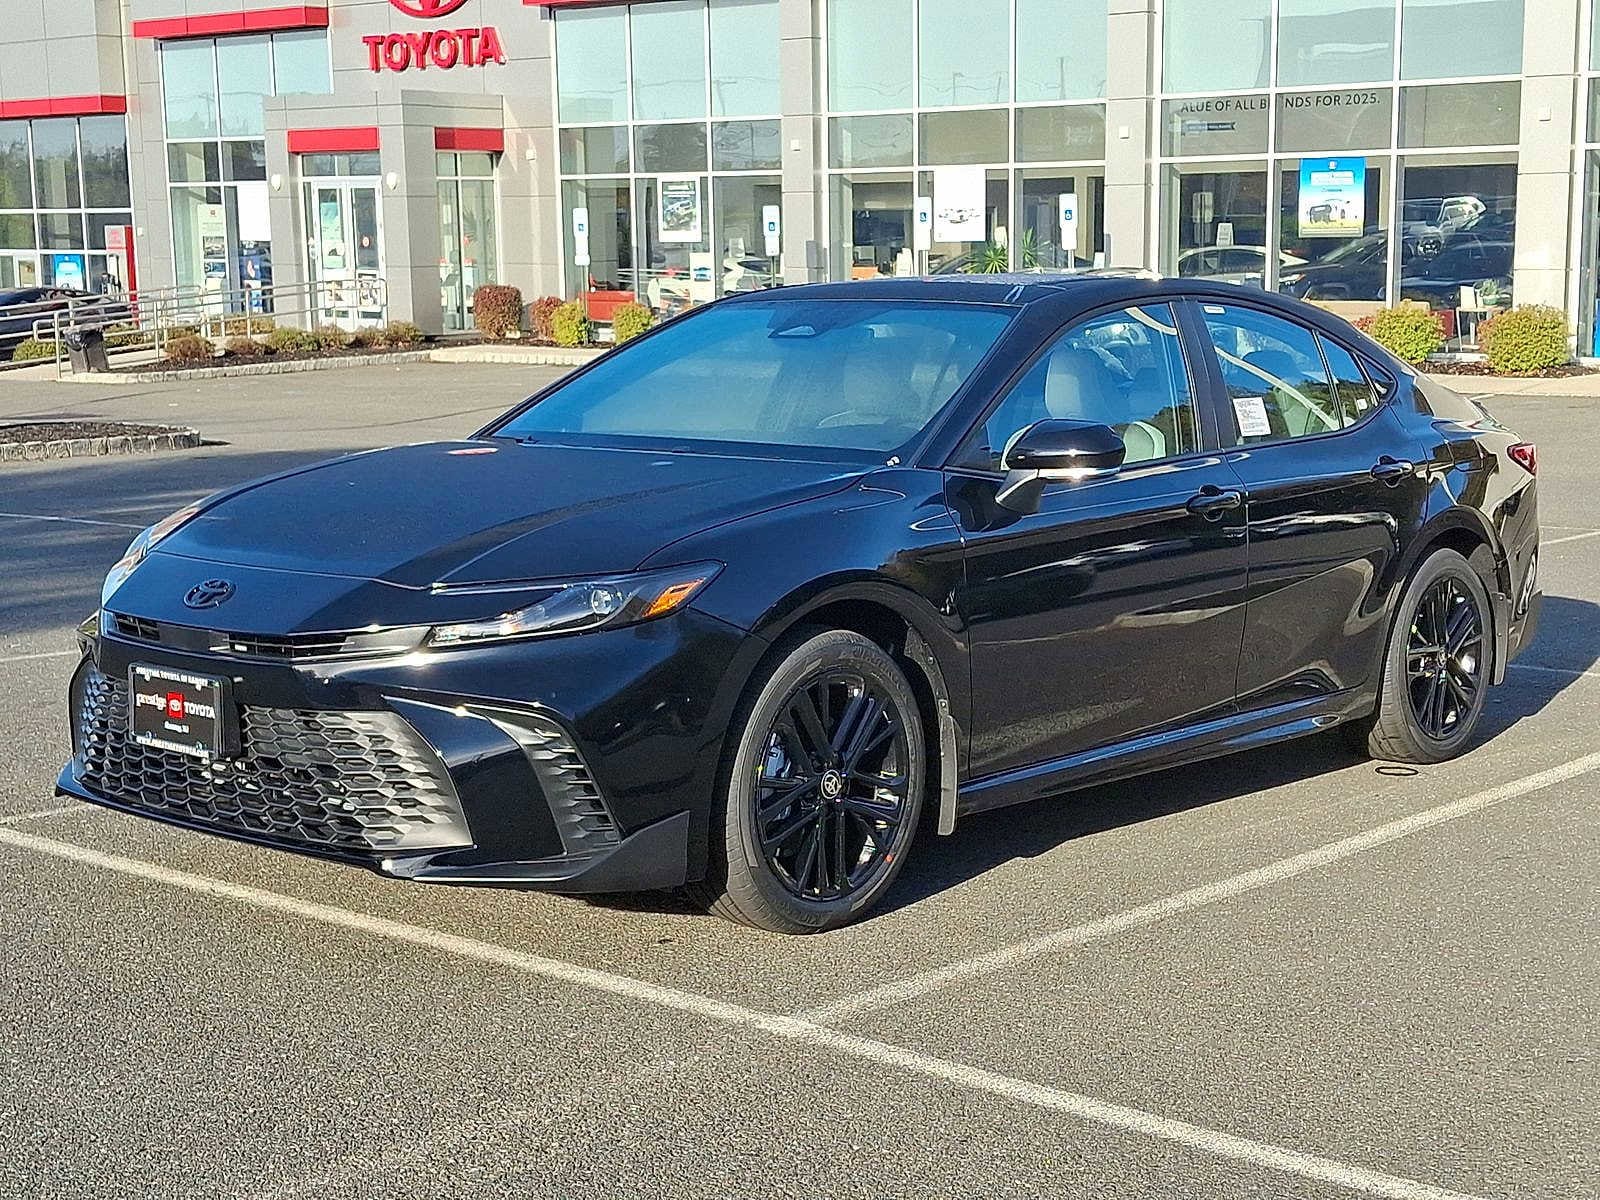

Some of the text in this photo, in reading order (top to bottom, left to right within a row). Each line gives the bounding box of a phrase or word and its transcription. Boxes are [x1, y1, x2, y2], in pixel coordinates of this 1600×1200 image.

[362, 27, 506, 73] TOYOTA
[1180, 101, 1212, 113] ALUE
[1214, 100, 1232, 112] OF
[1234, 99, 1257, 111] ALL
[1315, 94, 1341, 107] FOR
[1345, 92, 1381, 105] 2025.
[183, 701, 215, 719] TOYOTA
